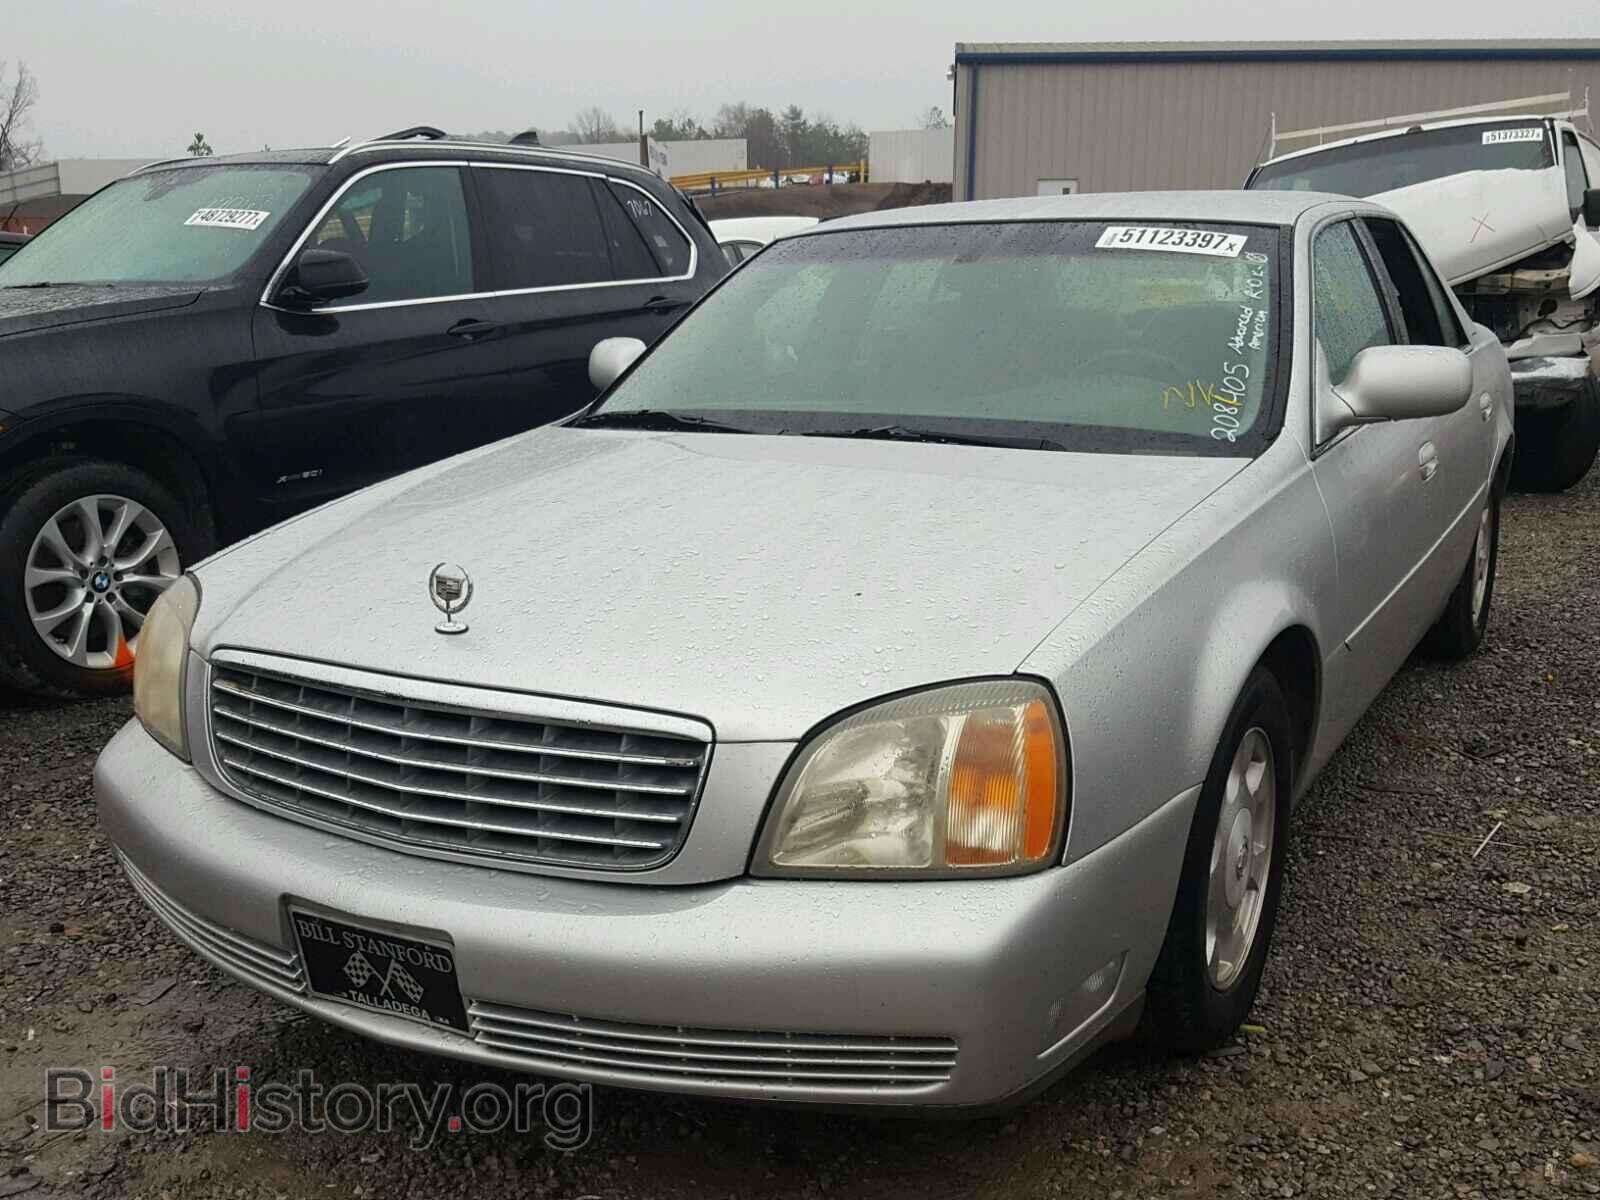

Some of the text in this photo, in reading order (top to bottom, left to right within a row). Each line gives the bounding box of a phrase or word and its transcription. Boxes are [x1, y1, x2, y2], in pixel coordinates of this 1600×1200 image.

[296, 919, 453, 974] BILL STANFORD
[349, 989, 432, 1021] TALLADEGA
